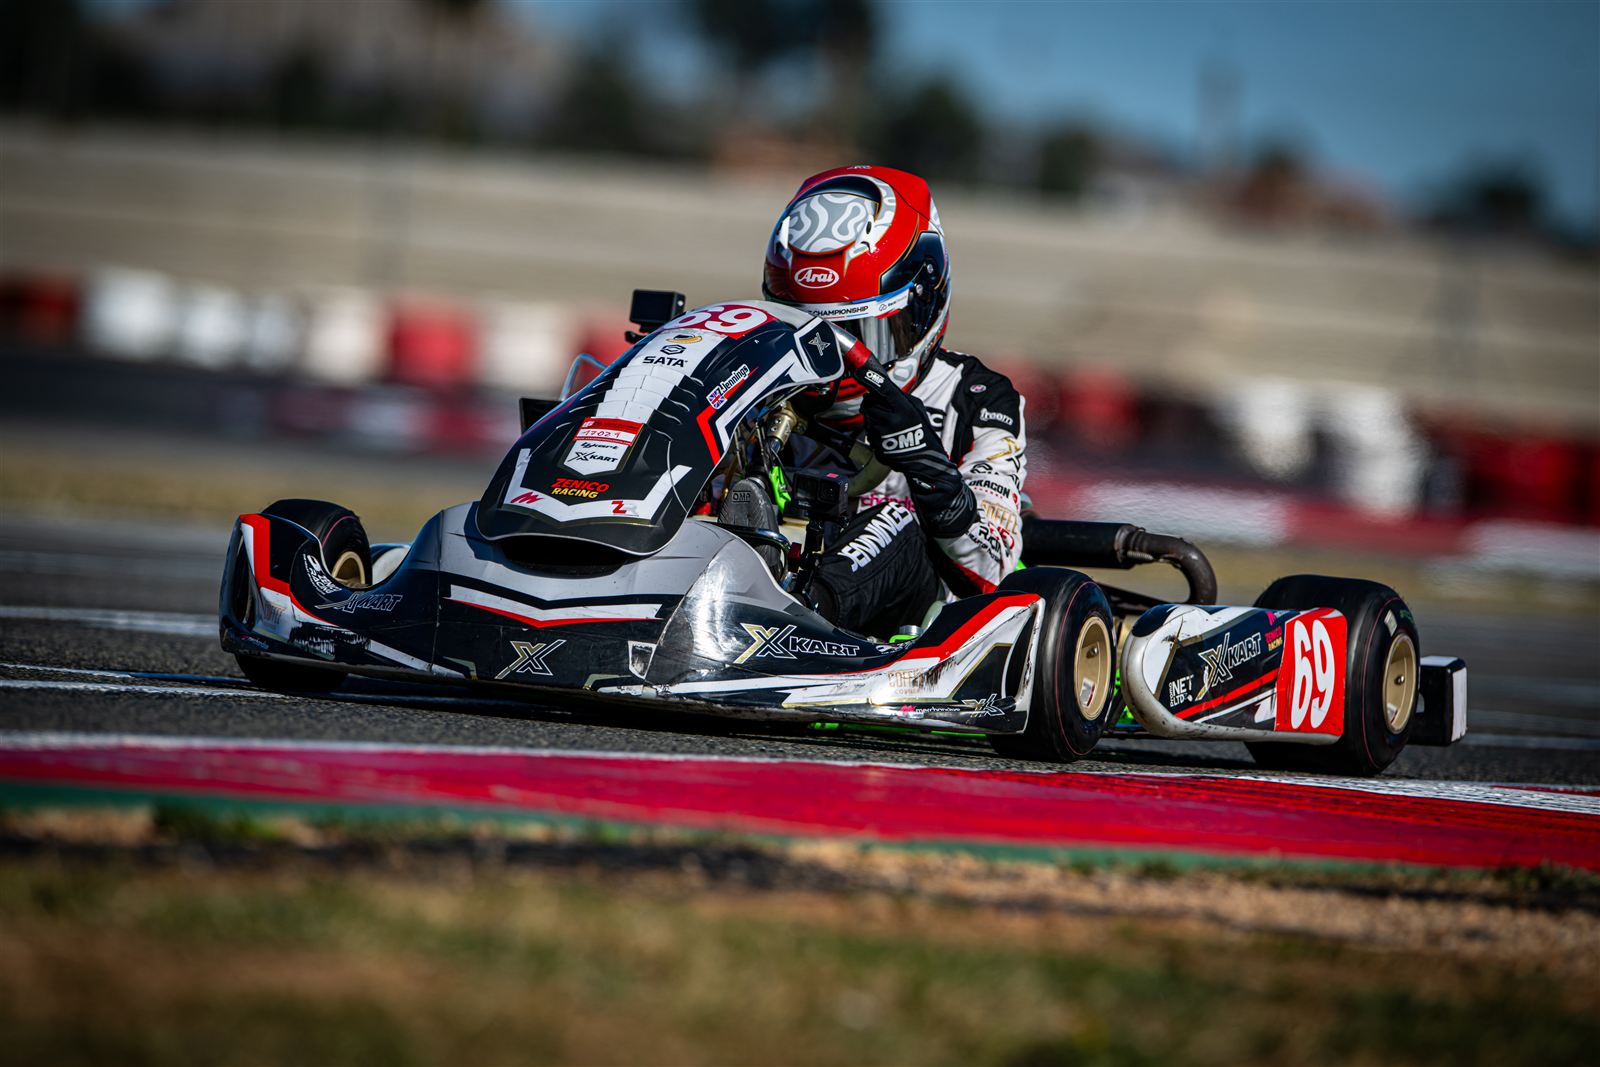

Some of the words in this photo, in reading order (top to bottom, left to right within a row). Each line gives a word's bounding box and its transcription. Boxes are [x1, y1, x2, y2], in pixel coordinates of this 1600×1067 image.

[797, 269, 834, 283] Arai
[663, 305, 768, 333] 69
[642, 355, 686, 368] SATA
[866, 371, 884, 385] OMP
[881, 428, 926, 450] OMP
[550, 478, 610, 493] ZENICO
[551, 487, 598, 499] RACING
[1290, 619, 1337, 730] 69
[1172, 674, 1195, 696] NET
